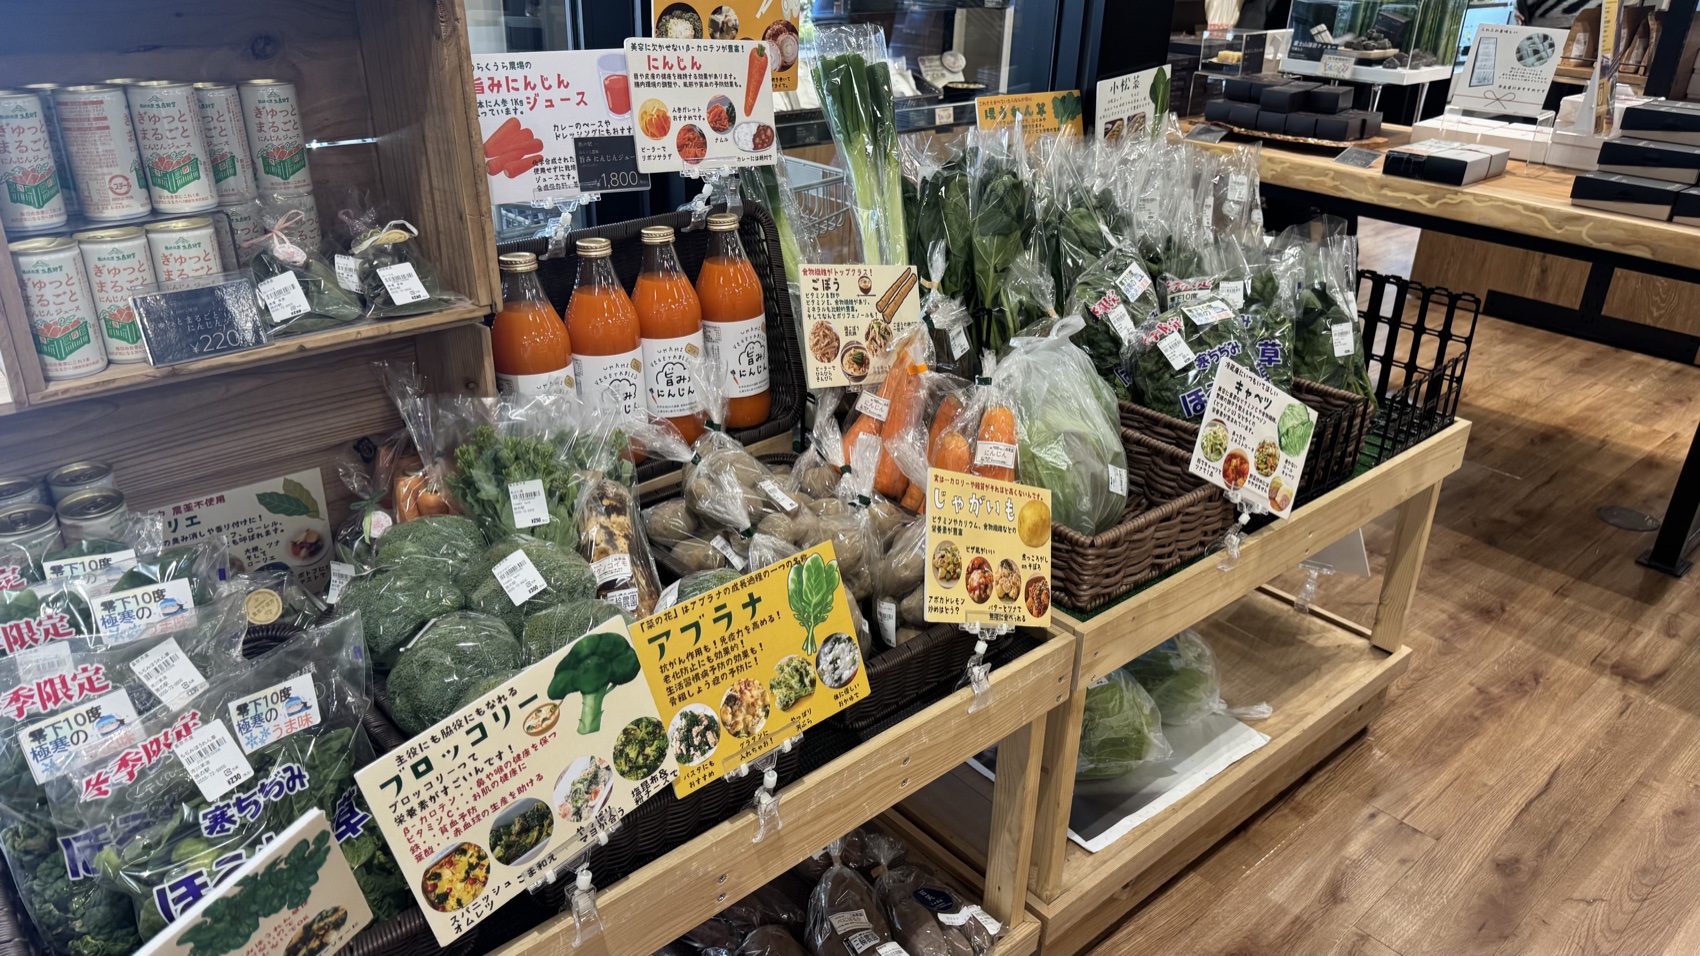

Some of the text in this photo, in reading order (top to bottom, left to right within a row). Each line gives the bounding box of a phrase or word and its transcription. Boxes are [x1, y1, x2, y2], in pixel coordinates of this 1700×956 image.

[647, 55, 702, 71] にんじん
[474, 73, 570, 95] 旨みにんじん
[1110, 74, 1140, 95] 小松菜
[254, 104, 297, 119] ぎゅっと
[477, 107, 524, 117] っています。
[526, 91, 588, 112] ジュース
[137, 109, 188, 126] ぎゅっと
[256, 119, 299, 133] まるごと
[673, 114, 706, 122] おすすめです。
[139, 125, 191, 142] まるごと
[93, 259, 147, 278] ぎゅっと
[161, 249, 213, 267] ぎゅっと
[812, 278, 840, 292] ごぼう
[1196, 340, 1242, 370] 寒ちぢみ
[1258, 341, 1282, 366] 草
[739, 365, 767, 379] にんじん
[1225, 361, 1279, 398] 冷蔵庫にいつもいてほしい
[657, 386, 695, 399] にんじん
[1235, 380, 1273, 411] キャベツ
[984, 449, 1007, 460] にんじん
[171, 495, 226, 516] 農薬不使用
[934, 487, 1016, 523] じゃがいも
[245, 550, 267, 561] そして
[246, 555, 276, 567] ローリエ
[50, 557, 112, 577] 零下10度
[100, 588, 166, 613] 零下10度
[927, 605, 960, 615] 炒めはどう？
[928, 596, 966, 606] アボカドレモン
[101, 606, 152, 632] 極寒の
[647, 591, 763, 663] アブラナ
[659, 610, 782, 675] 抗がん作用も！免疫力を高める！
[662, 639, 746, 685] 老化防止にも効果的！
[665, 642, 765, 698] 生活習慣病予防の効果も！
[668, 655, 760, 708] 骨粗しょう症の予防に！
[832, 682, 860, 702] 体に優しい
[235, 686, 292, 716] 零下10度
[837, 693, 862, 709] おかゆで
[28, 705, 102, 745] 零下10度
[236, 709, 279, 738] 極寒の
[270, 712, 314, 740] うま味
[790, 707, 813, 724] やっぱり
[795, 716, 814, 733] 天ぷら
[394, 686, 519, 768] 主役にも脇役にもなれる
[30, 729, 89, 763] 極寒の
[379, 692, 540, 798] ブロッコリー
[739, 730, 769, 751] グラタンに
[739, 737, 775, 762] 入れちゃお！
[683, 760, 715, 782] パスタにも
[688, 770, 715, 790] おすすめ
[388, 752, 480, 814] ブロッコリーって
[393, 745, 516, 828] 栄養素がすごいんです！
[201, 764, 309, 836] 寒ちぢみ
[580, 807, 626, 846] マヨが合う
[517, 853, 559, 887] ごま和え
[449, 879, 513, 926] スパニッシュ
[453, 900, 496, 936] オムレツ
